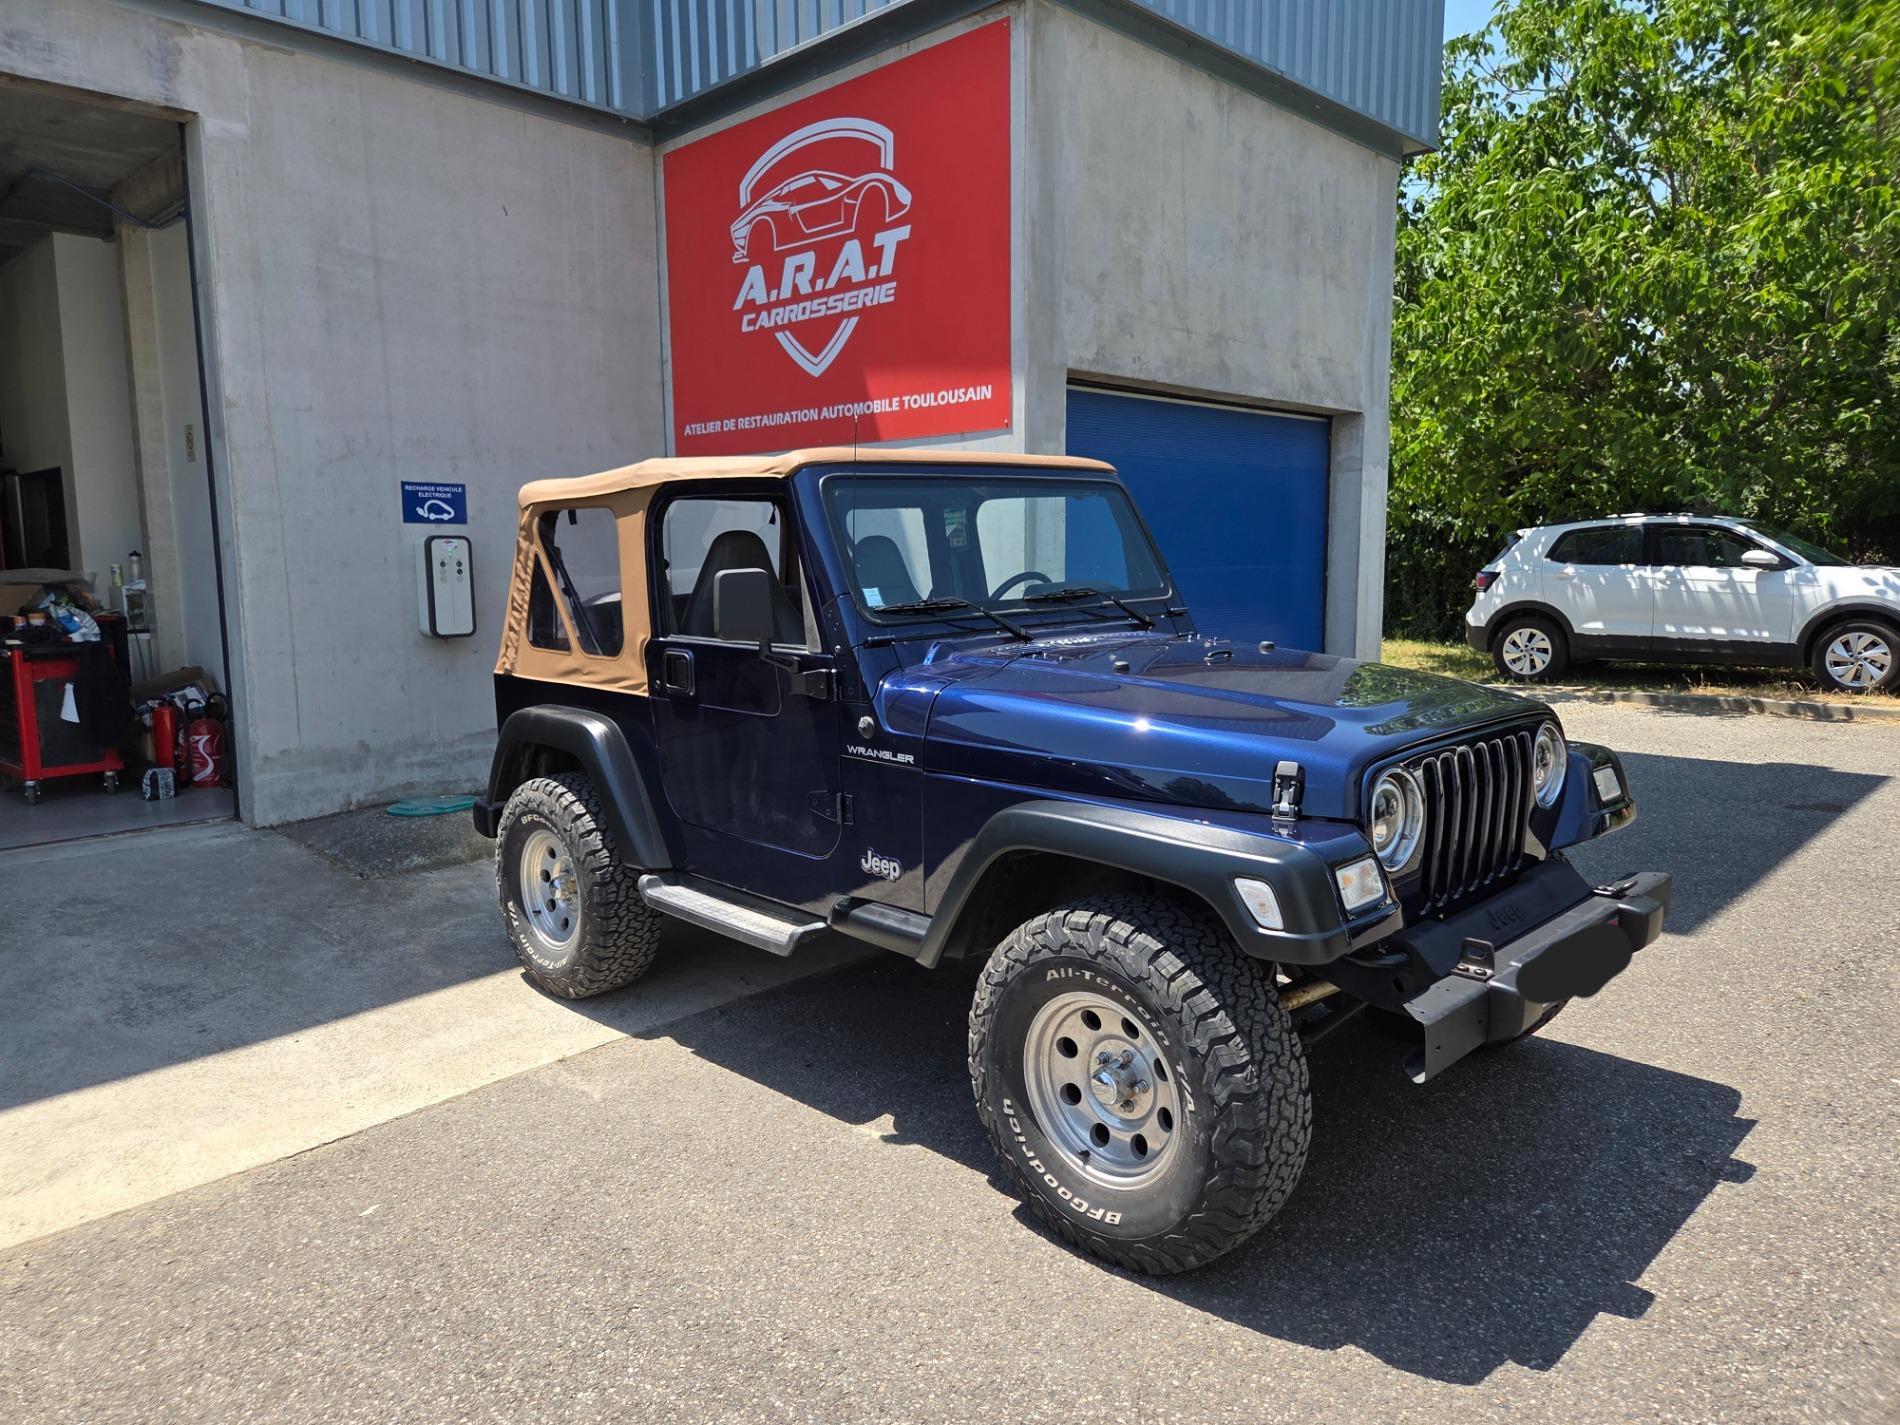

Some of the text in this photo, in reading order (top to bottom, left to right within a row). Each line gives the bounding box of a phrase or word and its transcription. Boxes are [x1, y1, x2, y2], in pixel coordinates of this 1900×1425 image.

[733, 225, 911, 311] A.R.A.T
[741, 281, 897, 333] CARROSSERIE
[684, 384, 992, 436] ATELIER DE RESTAURATION AUTOMOBILE TOULOUSAIN
[847, 744, 915, 764] WRANGLER
[861, 848, 902, 882] Jeep
[1046, 967, 1196, 1112] All-Terrain T/A
[1003, 1098, 1122, 1226] BFGoodrich
